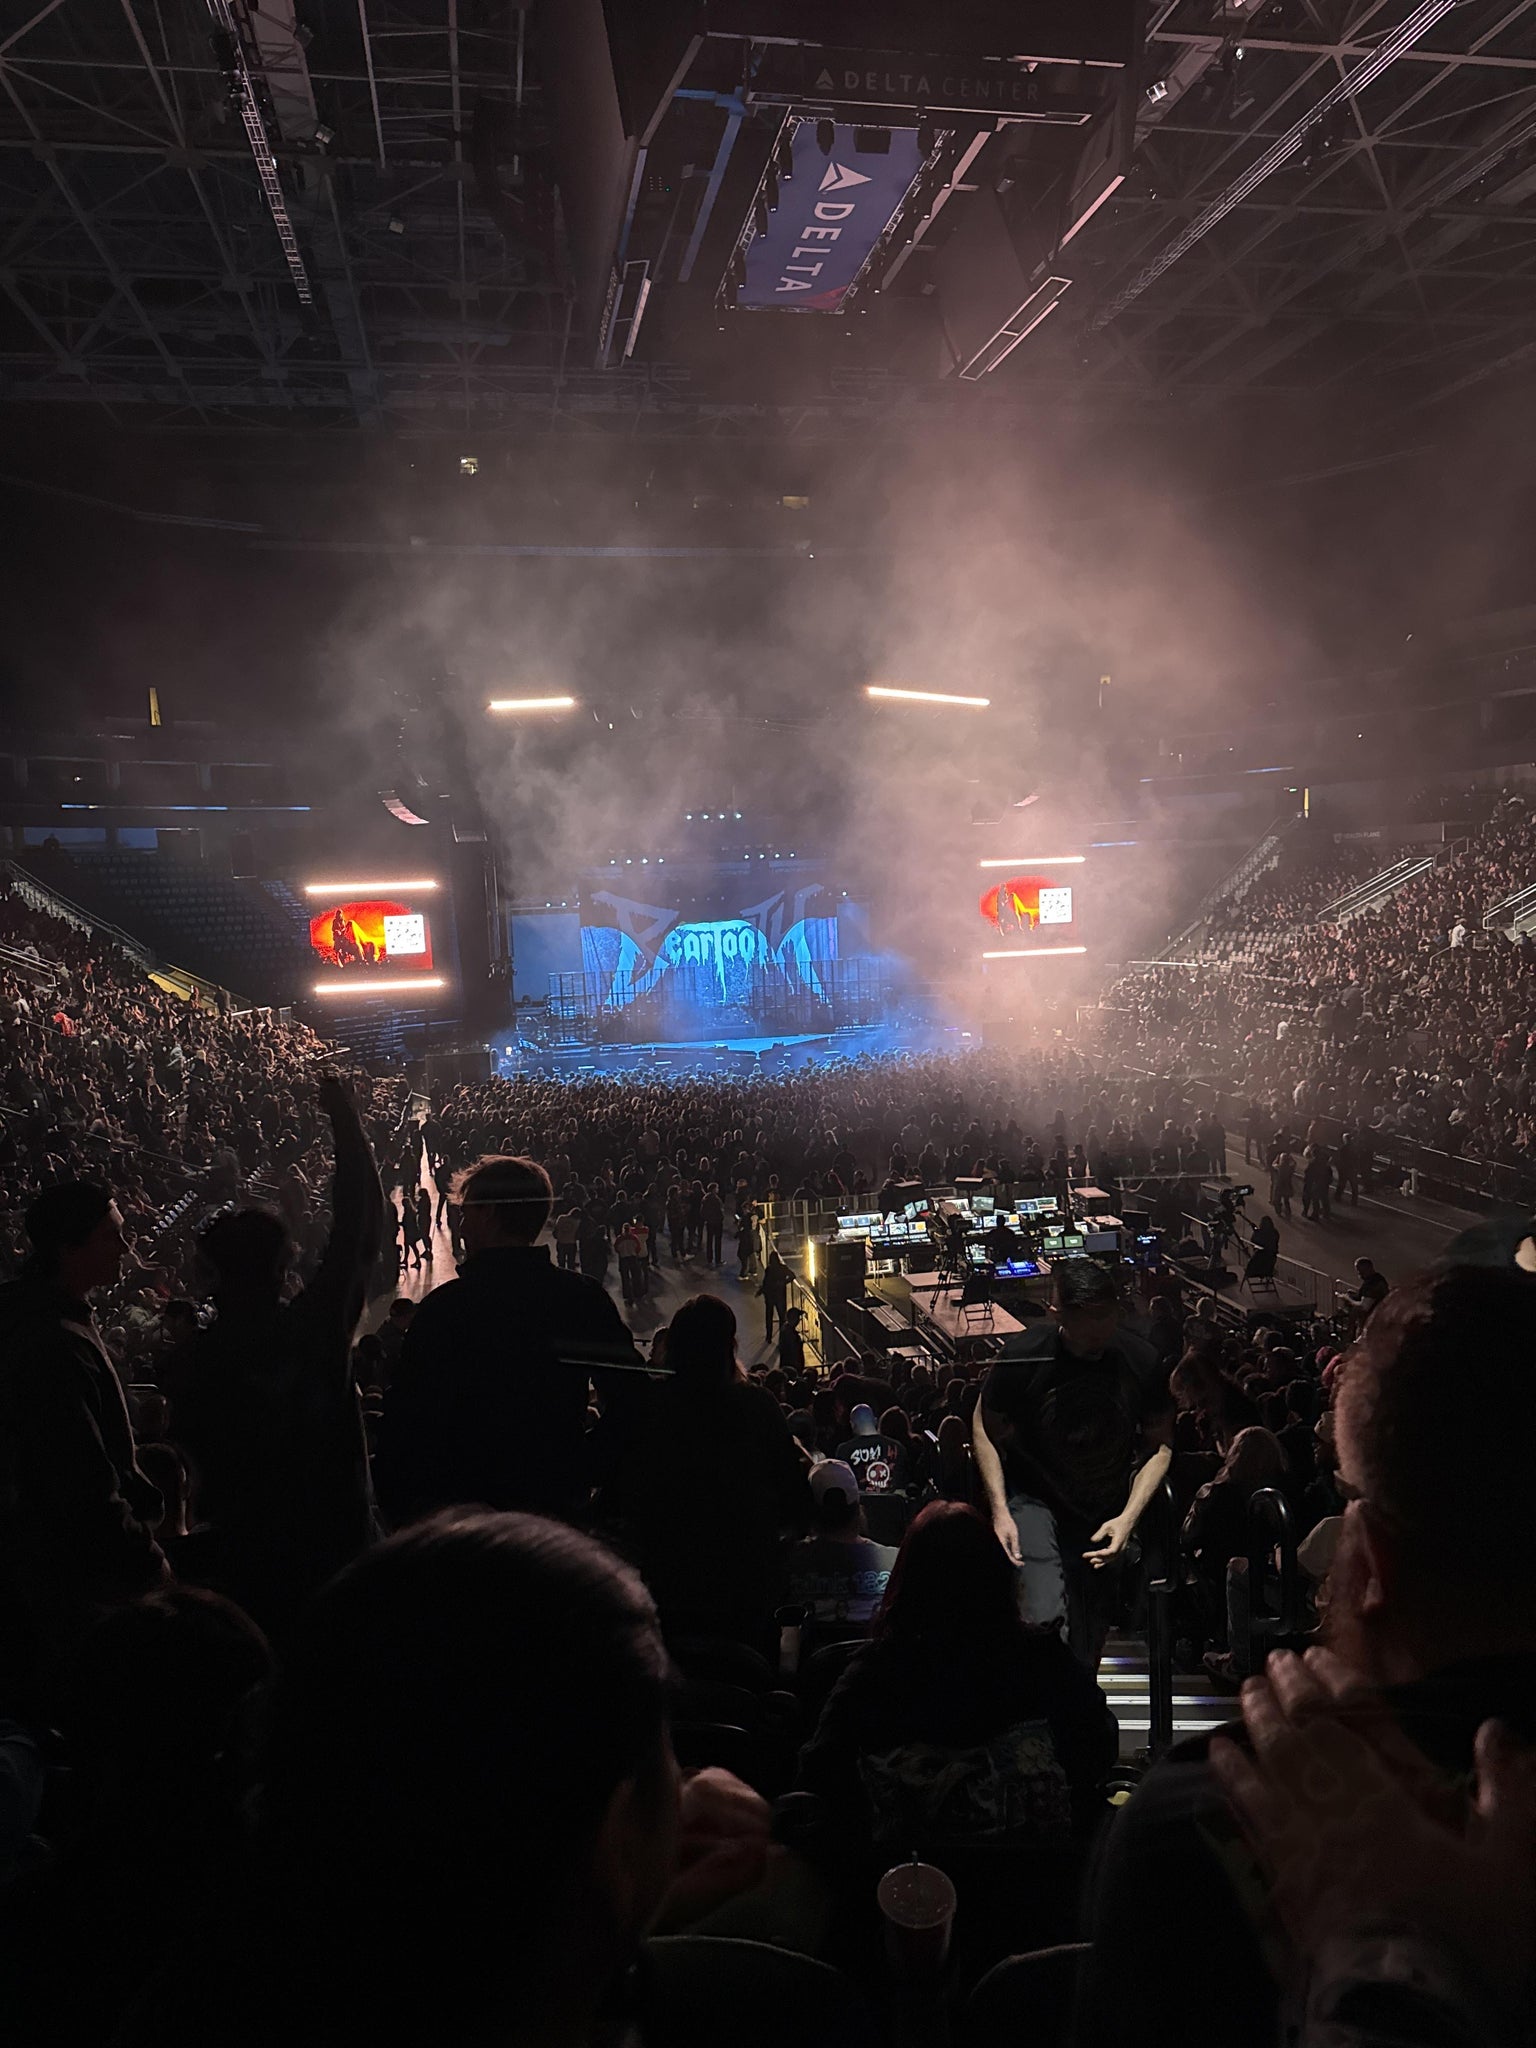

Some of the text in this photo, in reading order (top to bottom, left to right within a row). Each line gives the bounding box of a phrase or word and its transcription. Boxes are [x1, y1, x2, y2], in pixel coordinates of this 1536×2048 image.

[844, 71, 1039, 101] DELTA CENTER
[775, 201, 856, 292] DELTA
